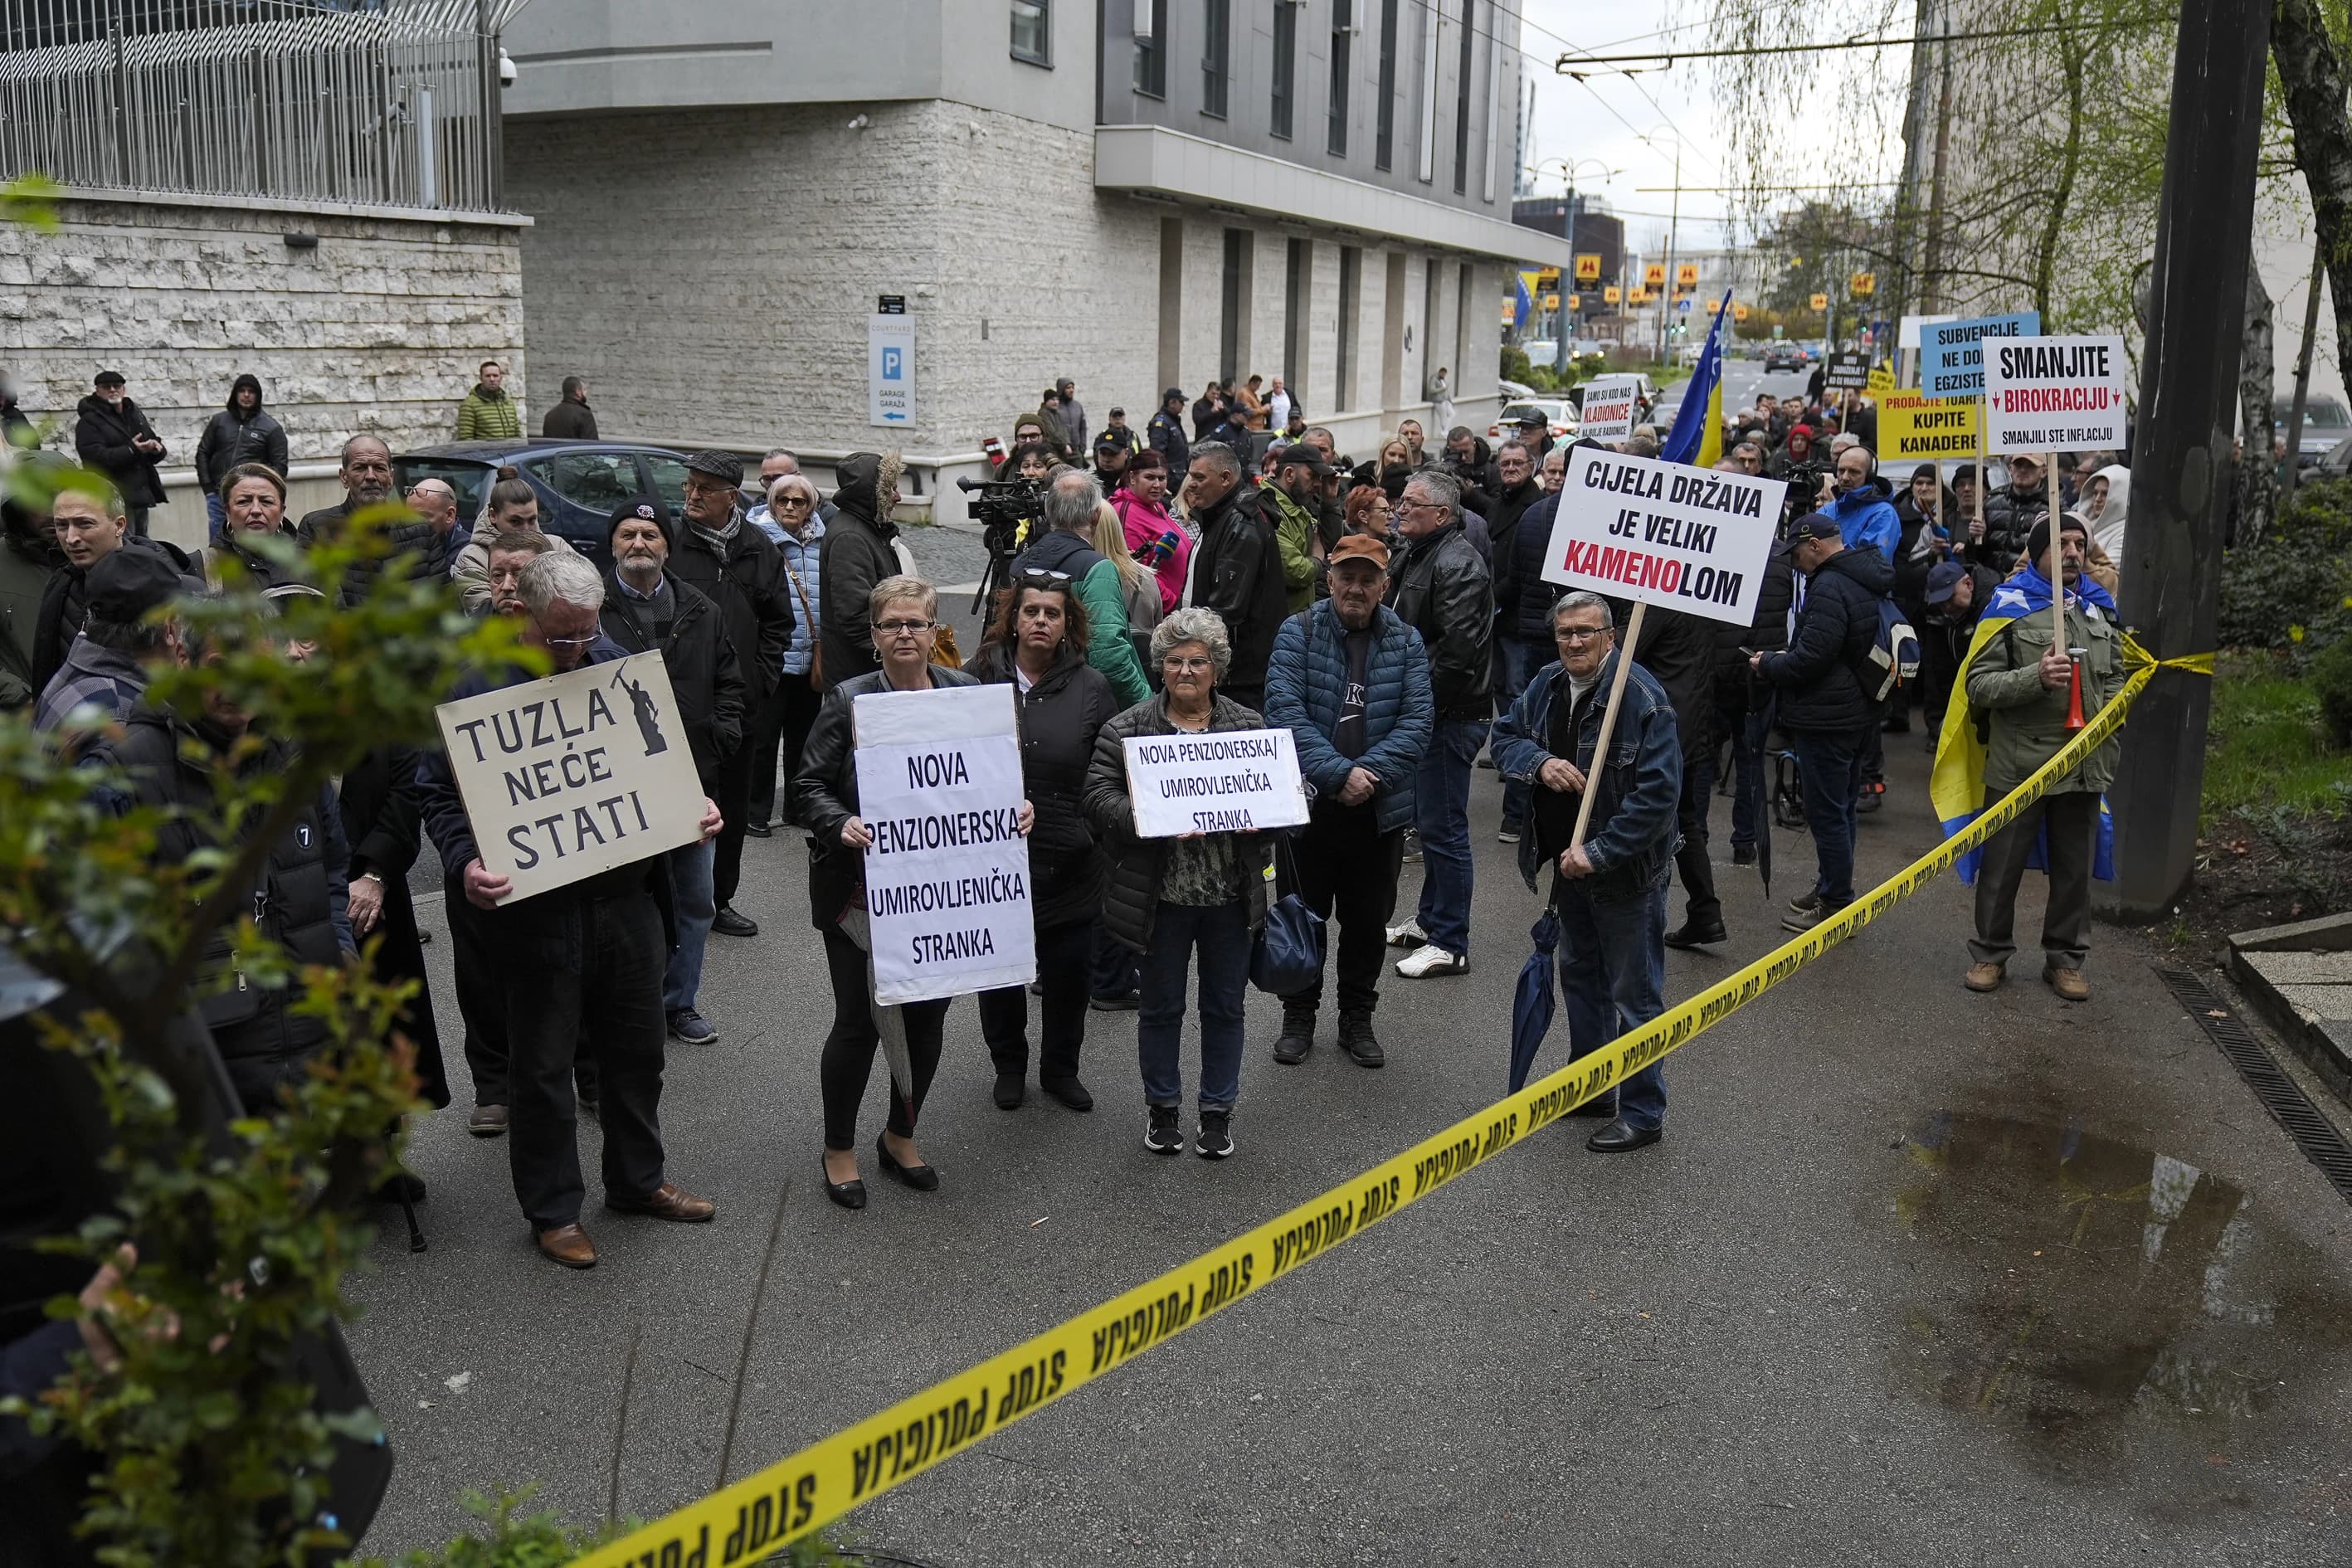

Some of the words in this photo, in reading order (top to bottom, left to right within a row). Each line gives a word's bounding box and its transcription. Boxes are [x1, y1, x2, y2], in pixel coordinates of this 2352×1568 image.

[1938, 321, 2019, 345] SUBVENCIJE
[886, 353, 898, 375] P
[1942, 352, 1959, 368] NE
[2000, 346, 2110, 379] SMANJITE
[879, 390, 905, 398] GARAGE
[1586, 392, 1600, 402] SAMO
[1601, 389, 1608, 400] SU
[1609, 388, 1619, 399] KOD
[1619, 387, 1632, 398] NAS
[1935, 373, 1985, 392] EGZISTE
[2004, 387, 2108, 412] BIROKRACIJU
[879, 400, 905, 408] GARAŽA
[1584, 402, 1629, 424] KLADIONICE
[1913, 411, 1965, 429] KUPITE
[1901, 434, 1977, 453] KANADERE
[2002, 430, 2046, 446] SMANJILI
[2048, 429, 2065, 442] STE
[2067, 427, 2112, 442] INFLACIJU
[1585, 461, 1663, 500] CIJELA
[1669, 475, 1762, 519] DRŽAVA
[1609, 509, 1640, 538] JE
[1644, 514, 1717, 553] VELIKI
[1563, 539, 1743, 607] KAMENOLOM
[455, 689, 617, 762] TUZLA
[1139, 742, 1177, 765] NOVA
[1180, 735, 1277, 762] PENZIONERSKA/
[501, 742, 612, 806] NEĆE
[908, 751, 969, 790] NOVA
[1160, 768, 1273, 799] UMIROVLJENIČKA
[300, 828, 309, 845] 7
[507, 790, 650, 869] STATI
[864, 806, 1022, 856] PENZIONERSKA
[1193, 808, 1254, 830] STRANKA
[871, 867, 1025, 918] UMIROVLJENIČKA
[913, 928, 995, 965] STRANKA
[1481, 1113, 1517, 1161] STOP
[1413, 1132, 1478, 1197] POLICIJA
[1356, 1175, 1400, 1230] STOP
[1271, 1199, 1353, 1276] POLICIJA
[1198, 1253, 1253, 1317] STOP
[1090, 1282, 1194, 1373] POLICIJA
[996, 1348, 1066, 1424] STOP
[851, 1386, 989, 1499] POLICIJA
[721, 1472, 816, 1566] STOP
